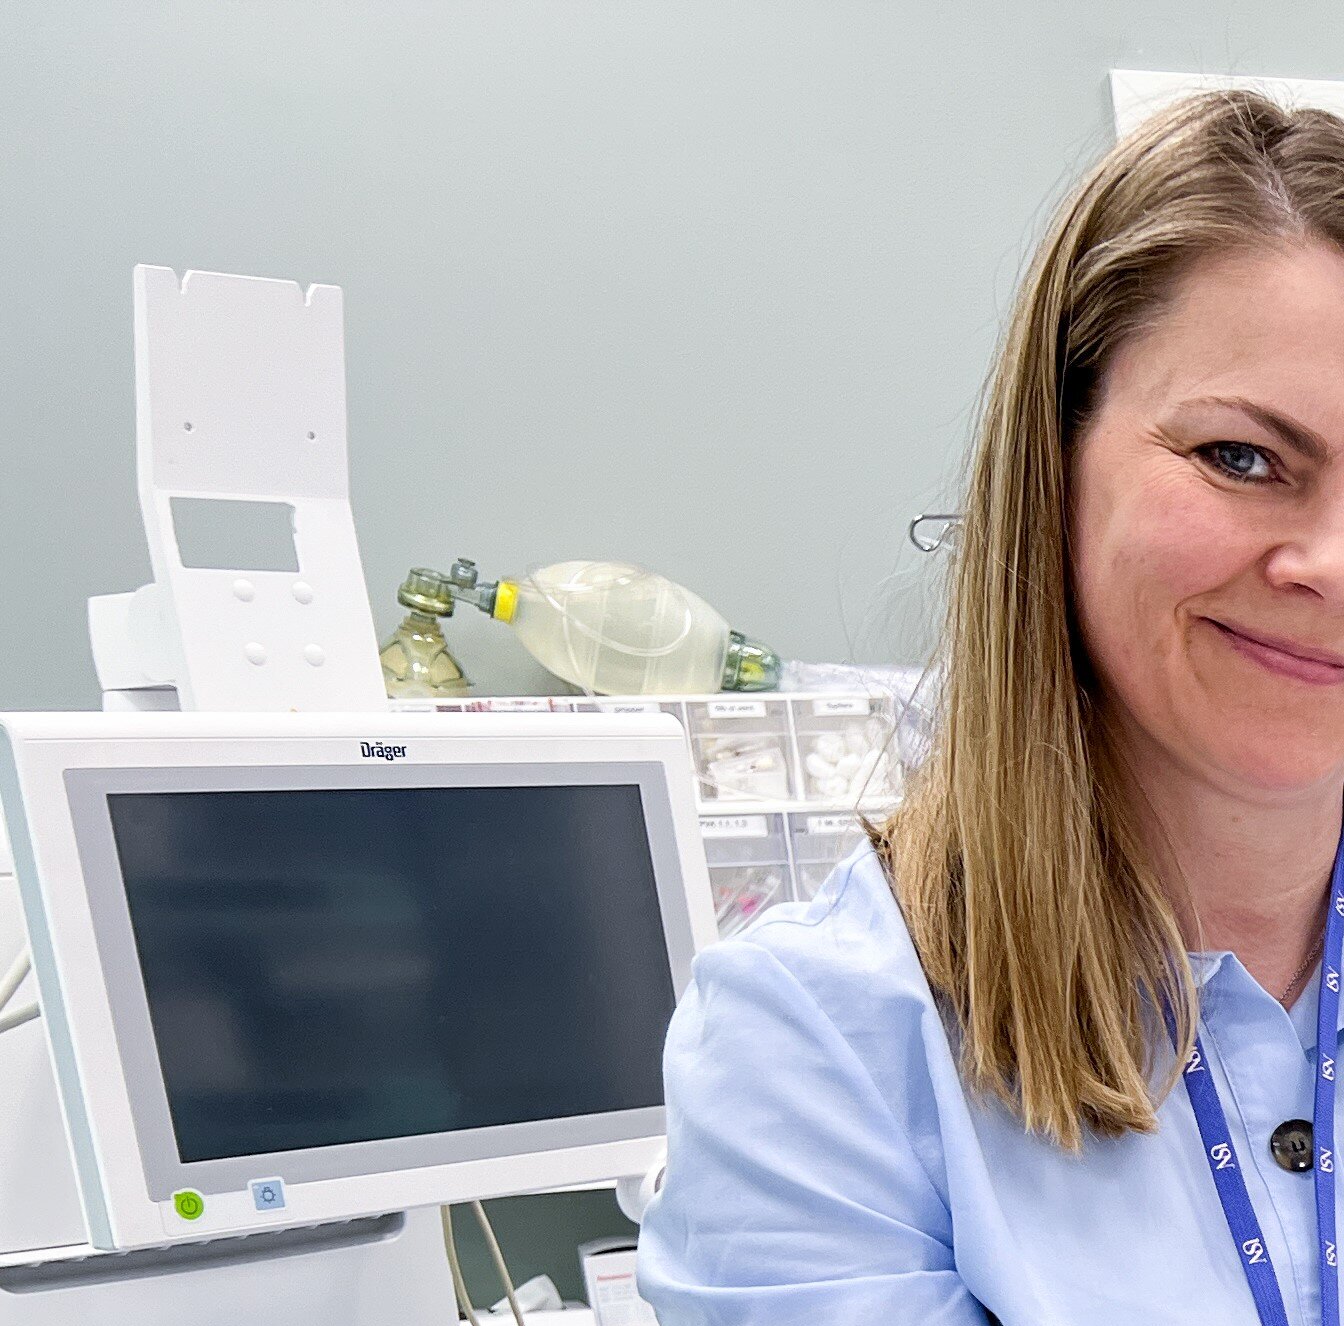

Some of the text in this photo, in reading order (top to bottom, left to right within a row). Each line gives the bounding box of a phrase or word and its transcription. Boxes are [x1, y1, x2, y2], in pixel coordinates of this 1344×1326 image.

[360, 742, 407, 761] Dräger
[1211, 1142, 1235, 1170] USN
[1242, 1237, 1267, 1265] USN
